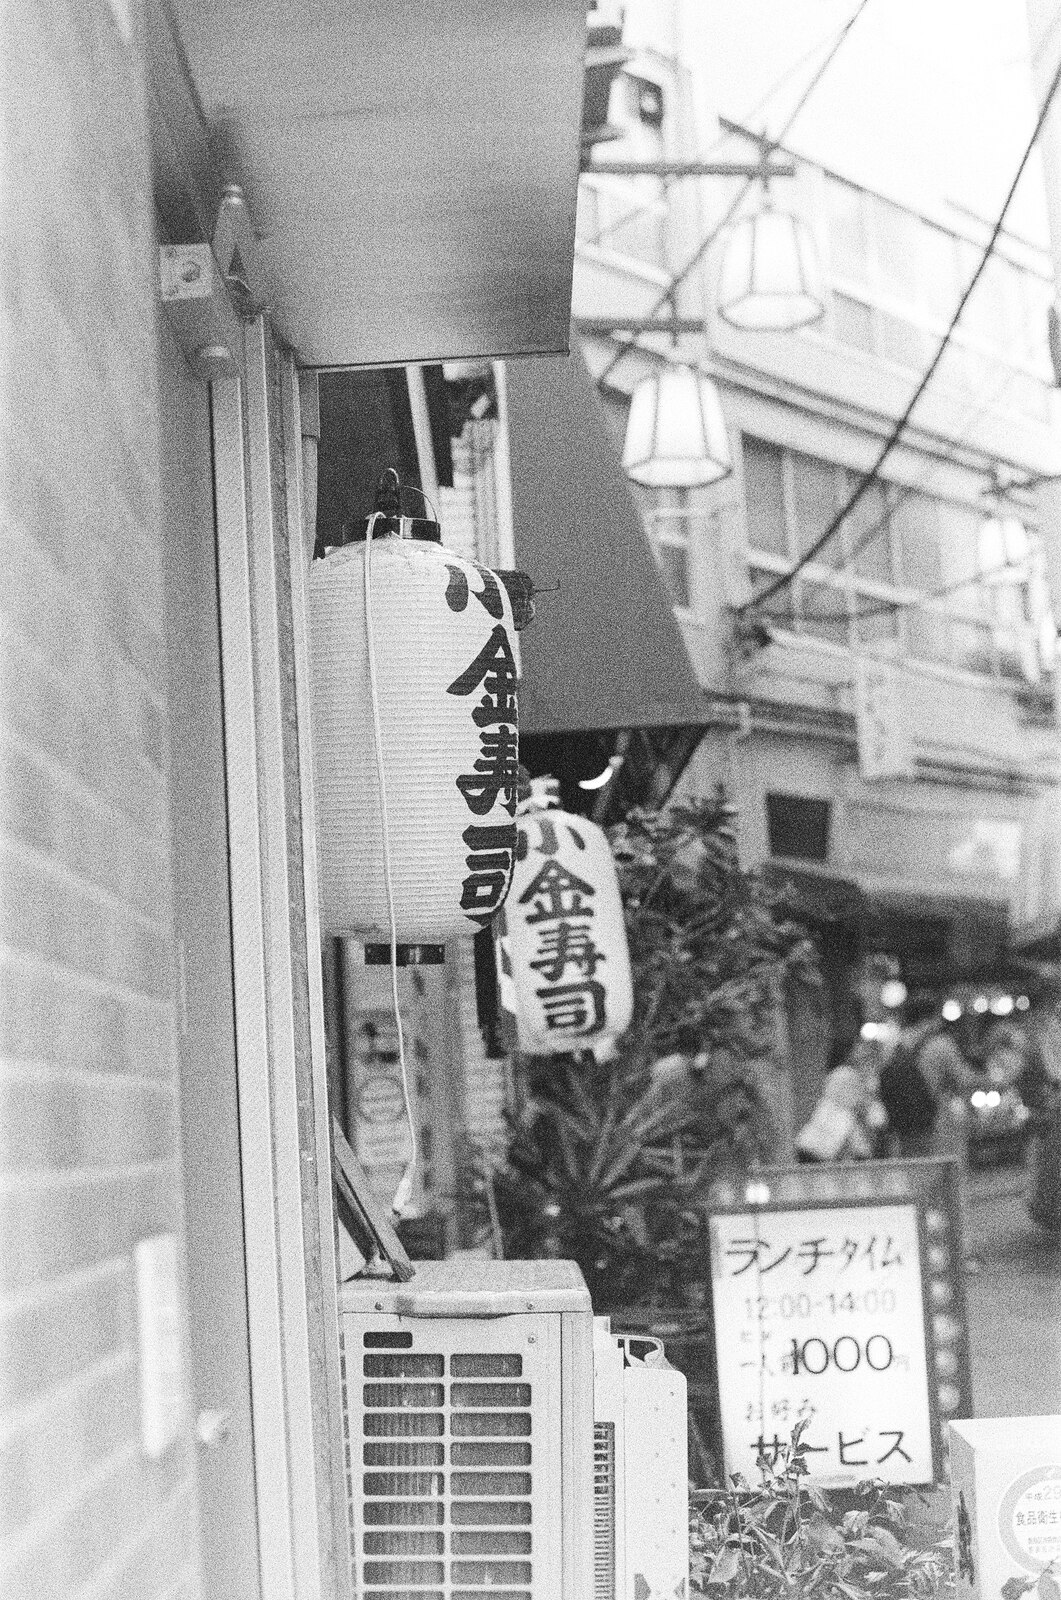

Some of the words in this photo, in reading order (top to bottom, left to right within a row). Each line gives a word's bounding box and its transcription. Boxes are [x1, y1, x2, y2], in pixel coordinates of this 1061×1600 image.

[444, 564, 518, 927] 小金寿司
[515, 818, 606, 1036] 小金寿司
[725, 1236, 903, 1276] ランチタイム
[750, 1428, 913, 1466] サービス
[1015, 1510, 1061, 1527] 食品衛生
